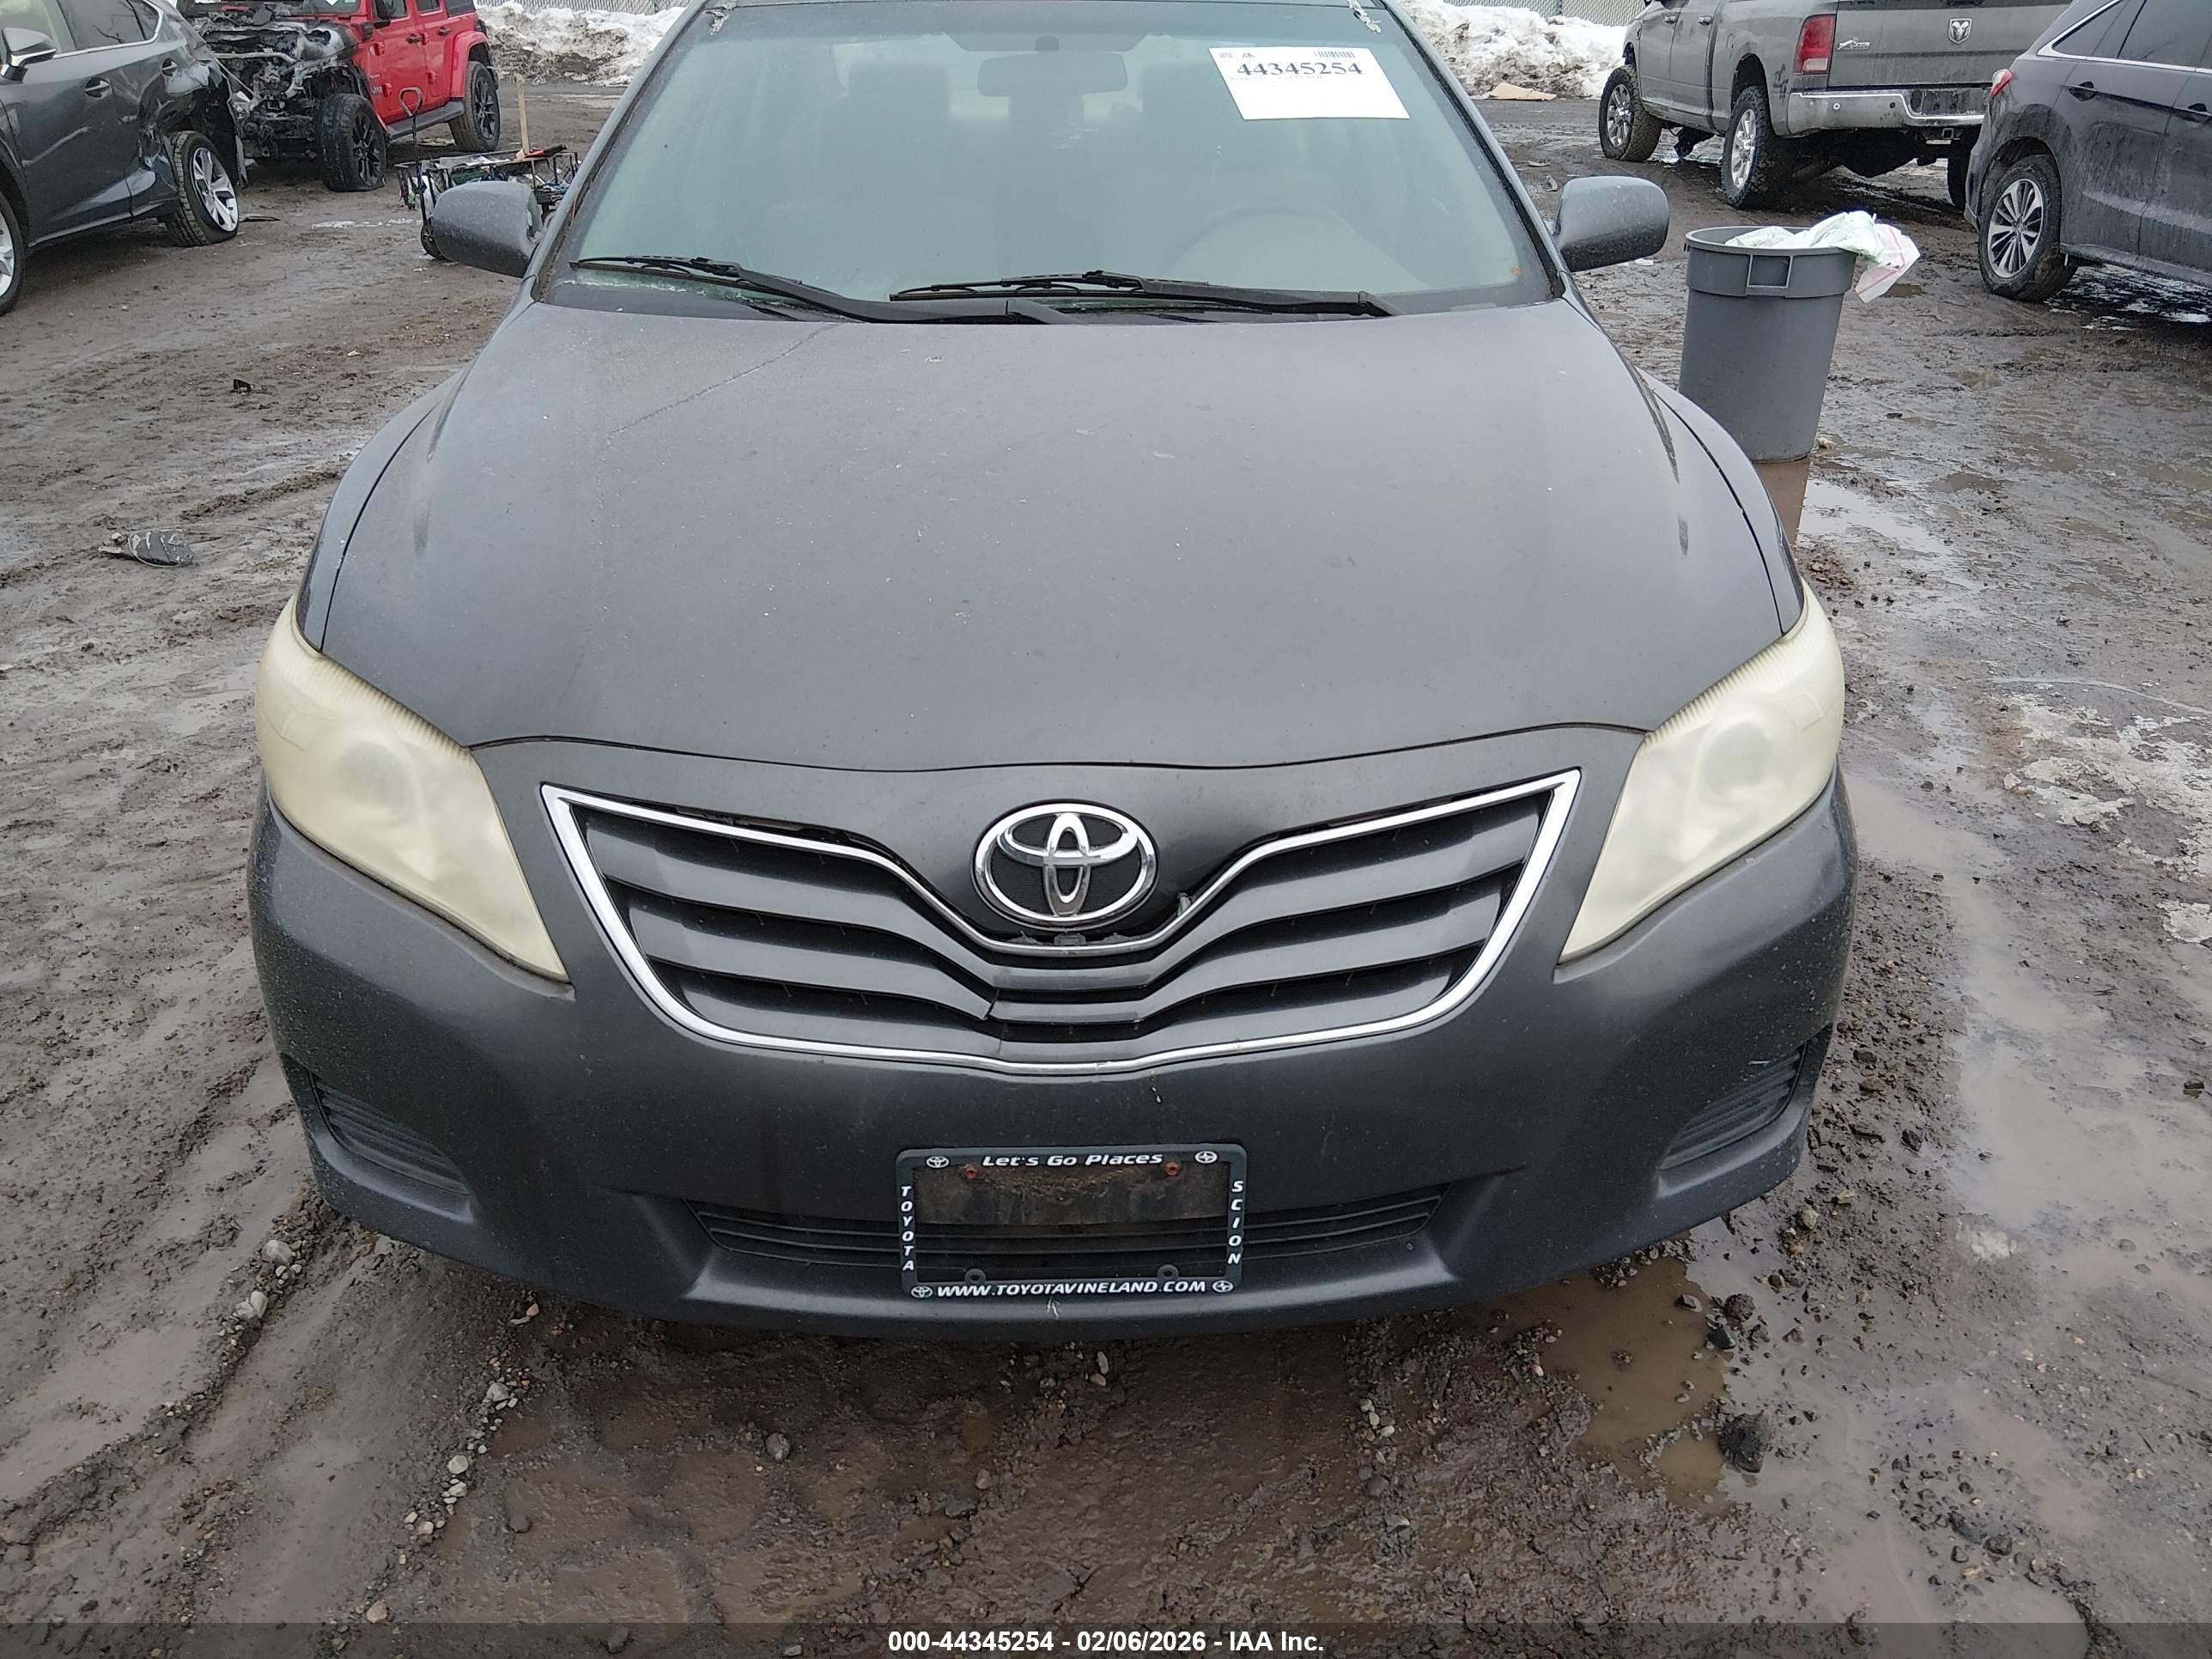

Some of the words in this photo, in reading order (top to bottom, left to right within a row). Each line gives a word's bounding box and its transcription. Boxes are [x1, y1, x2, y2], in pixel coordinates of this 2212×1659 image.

[1237, 63, 1363, 76] 44345254
[981, 1156, 1039, 1167] Let's
[1047, 1155, 1078, 1166] Go
[1085, 1154, 1163, 1166] Places
[900, 1185, 915, 1272] TOYOTA
[1226, 1180, 1244, 1265] SCION
[937, 1280, 1206, 1297] WWW.TOYOTAVINELAND.COM
